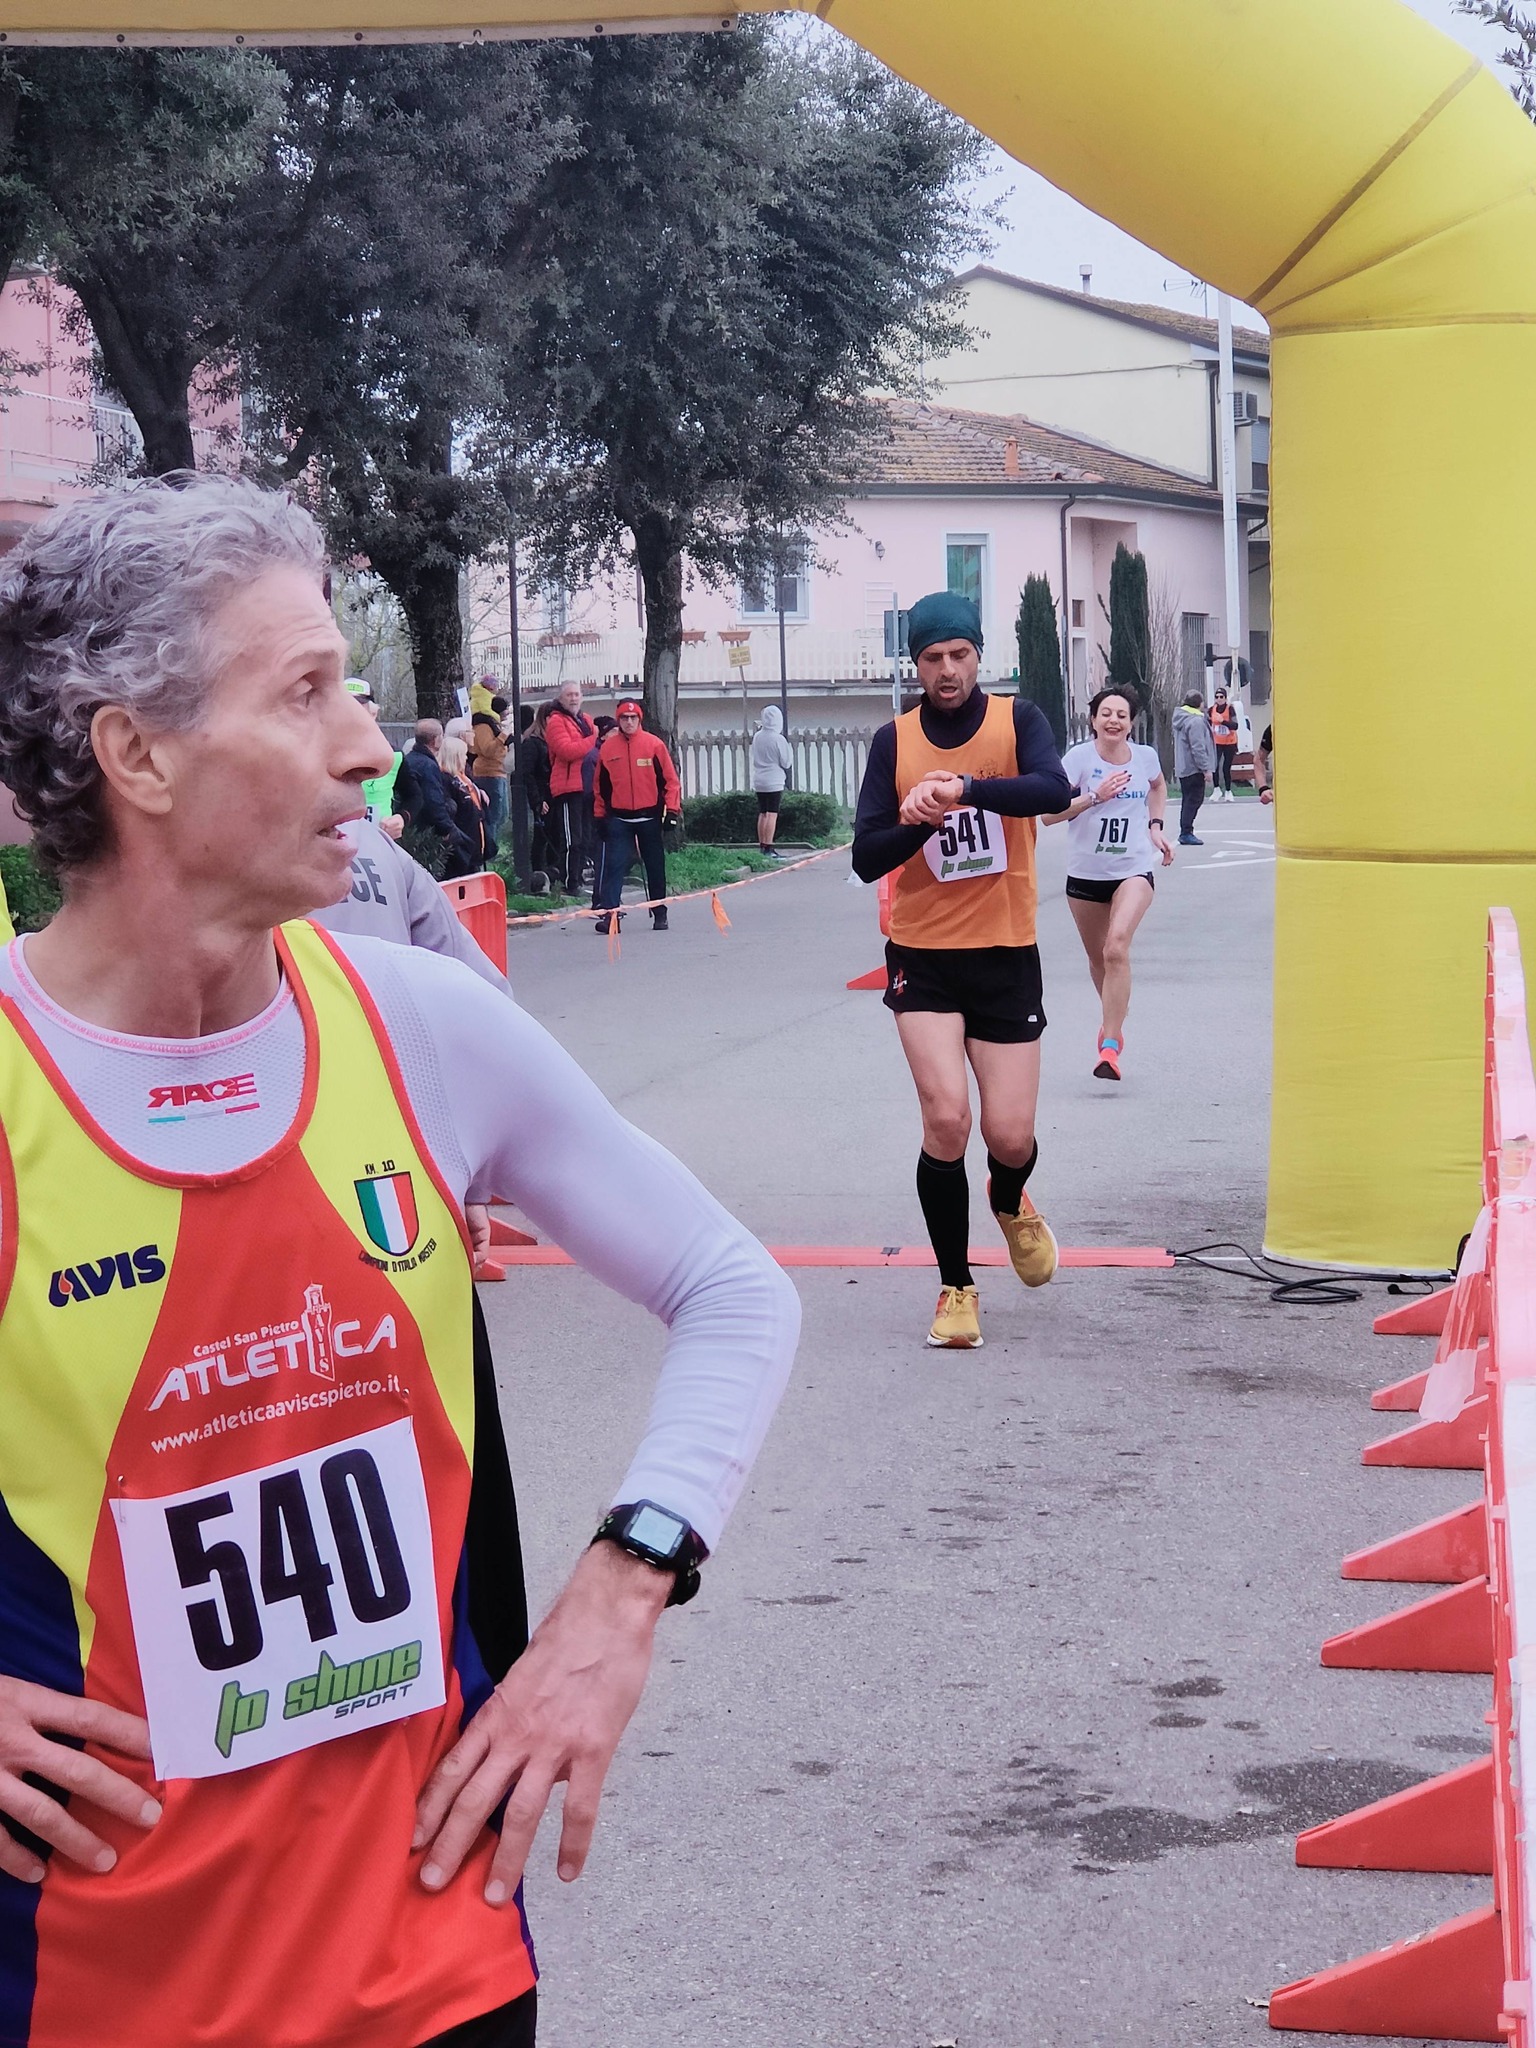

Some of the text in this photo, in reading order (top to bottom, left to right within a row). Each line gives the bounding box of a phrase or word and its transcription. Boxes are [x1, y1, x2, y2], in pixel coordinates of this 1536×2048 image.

[939, 808, 990, 857] 541
[1098, 817, 1129, 843] 767
[381, 1159, 396, 1173] 10
[48, 1243, 167, 1308] AVIS
[193, 1319, 300, 1358] Castel San Pietro
[150, 1374, 401, 1454] www.atleticaaviscspietro.it
[163, 1447, 412, 1671] 540
[333, 1682, 414, 1720] SPORT
